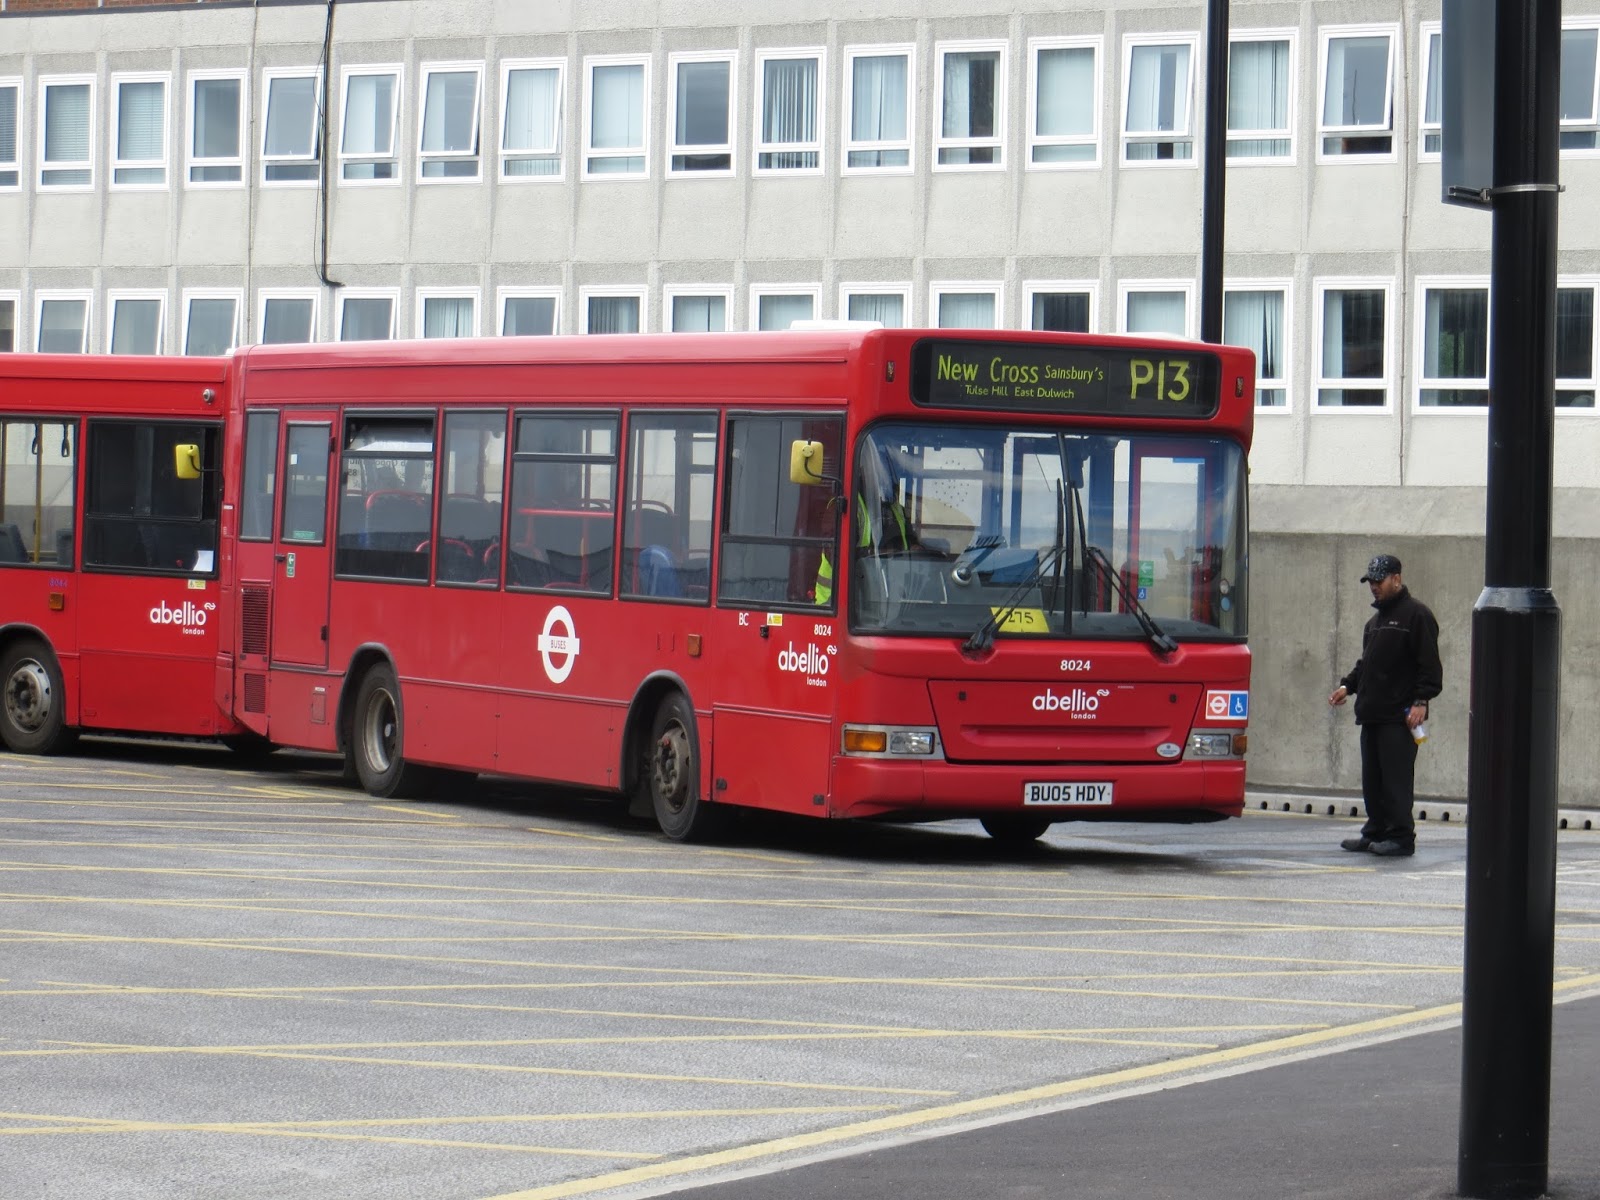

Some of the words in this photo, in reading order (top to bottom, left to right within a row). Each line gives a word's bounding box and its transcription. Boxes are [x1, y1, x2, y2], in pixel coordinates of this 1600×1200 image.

[937, 354, 978, 380] New
[990, 357, 1039, 384] Cross
[1044, 365, 1104, 384] Sainsbury's
[1130, 359, 1191, 401] P13
[965, 384, 989, 396] Tulse
[992, 386, 1008, 397] Hill
[1014, 386, 1034, 398] East
[1037, 387, 1074, 399] Dulwich
[149, 600, 207, 626] abellio
[739, 613, 749, 626] BC
[182, 627, 205, 635] london
[813, 624, 832, 636] 8024
[551, 640, 566, 650] BUSES
[778, 640, 829, 675] abellio
[1060, 659, 1091, 671] 8024
[806, 676, 827, 687] london
[1032, 689, 1098, 711] abellio
[1070, 712, 1096, 720] london
[1030, 785, 1071, 802] BU05
[1076, 785, 1107, 802] HDY
